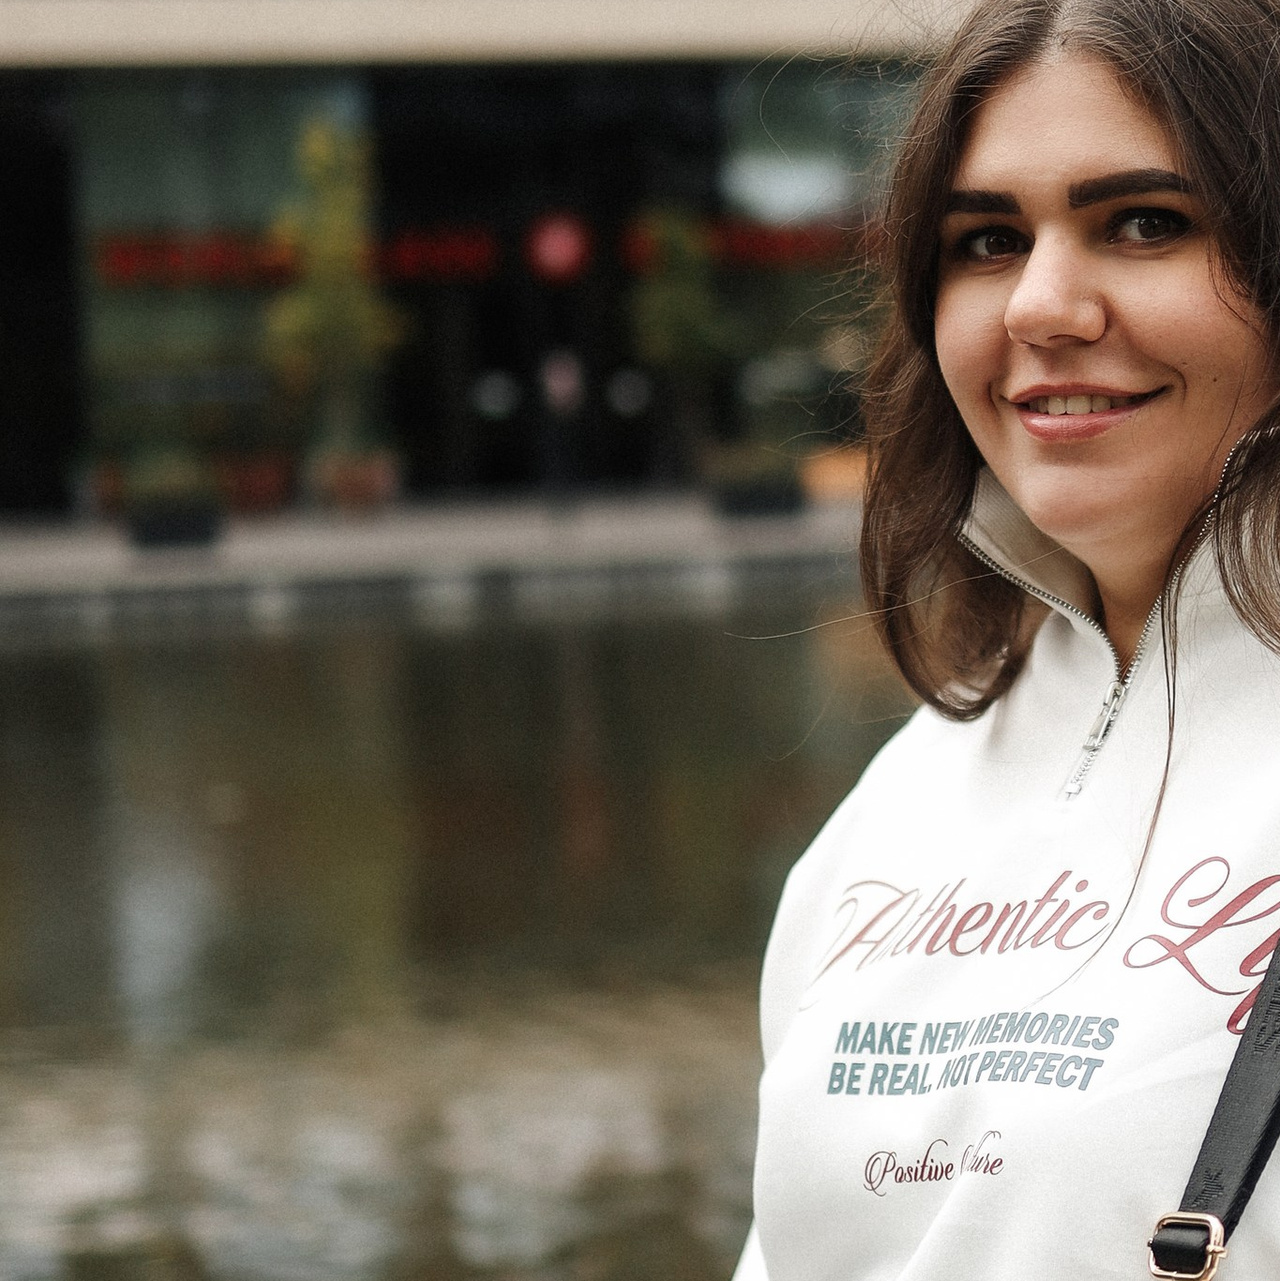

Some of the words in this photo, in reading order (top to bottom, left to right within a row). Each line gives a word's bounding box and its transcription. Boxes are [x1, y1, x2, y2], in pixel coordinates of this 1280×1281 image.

[834, 1022, 916, 1055] MAKE
[919, 1021, 976, 1055] NEW
[969, 1012, 1119, 1051] MEMORIES
[827, 1062, 865, 1095] BE
[936, 1053, 979, 1090] NOT
[975, 1051, 1104, 1091] PERFECT
[863, 1139, 955, 1197] Positive
